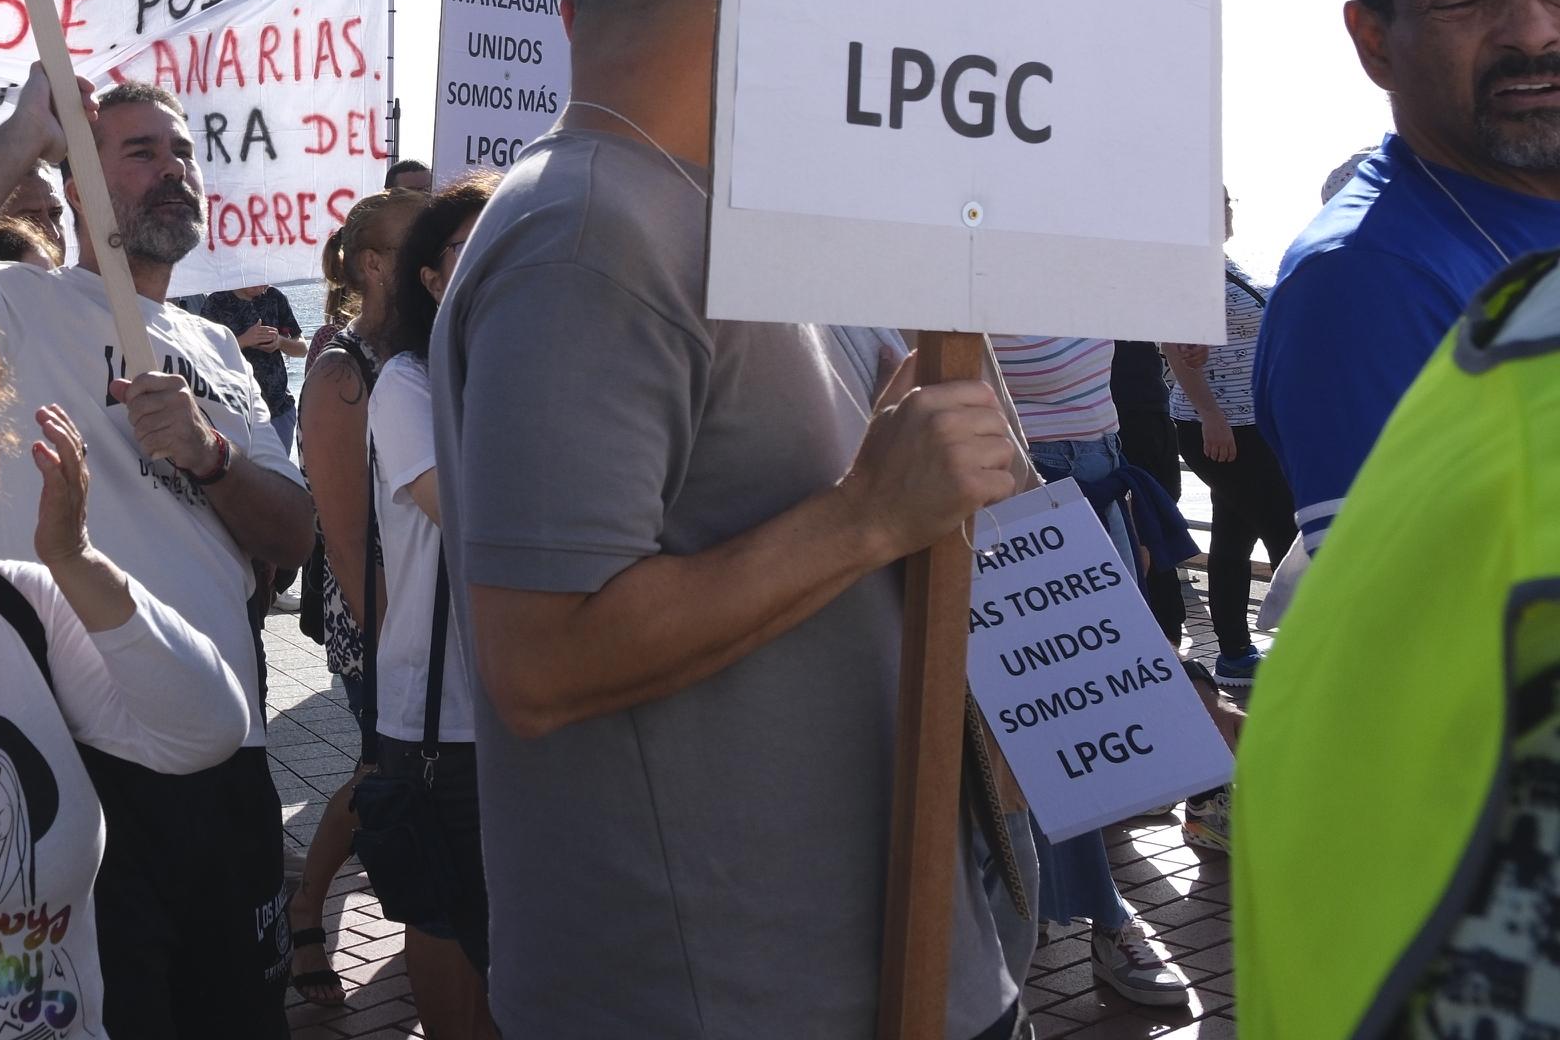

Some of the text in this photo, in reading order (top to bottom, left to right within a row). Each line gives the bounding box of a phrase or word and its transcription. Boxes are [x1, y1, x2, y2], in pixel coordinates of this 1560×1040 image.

[468, 31, 543, 65] UNIDOS
[446, 81, 558, 114] SOMOS MÁS
[846, 41, 1053, 144] LPGC
[302, 108, 388, 159] DEL
[466, 134, 523, 167] LPGC
[1002, 560, 1122, 617] TORRES
[999, 618, 1121, 677] UNIDOS
[999, 656, 1173, 734] SOMOS MÁS
[1056, 724, 1154, 780] LPGC
